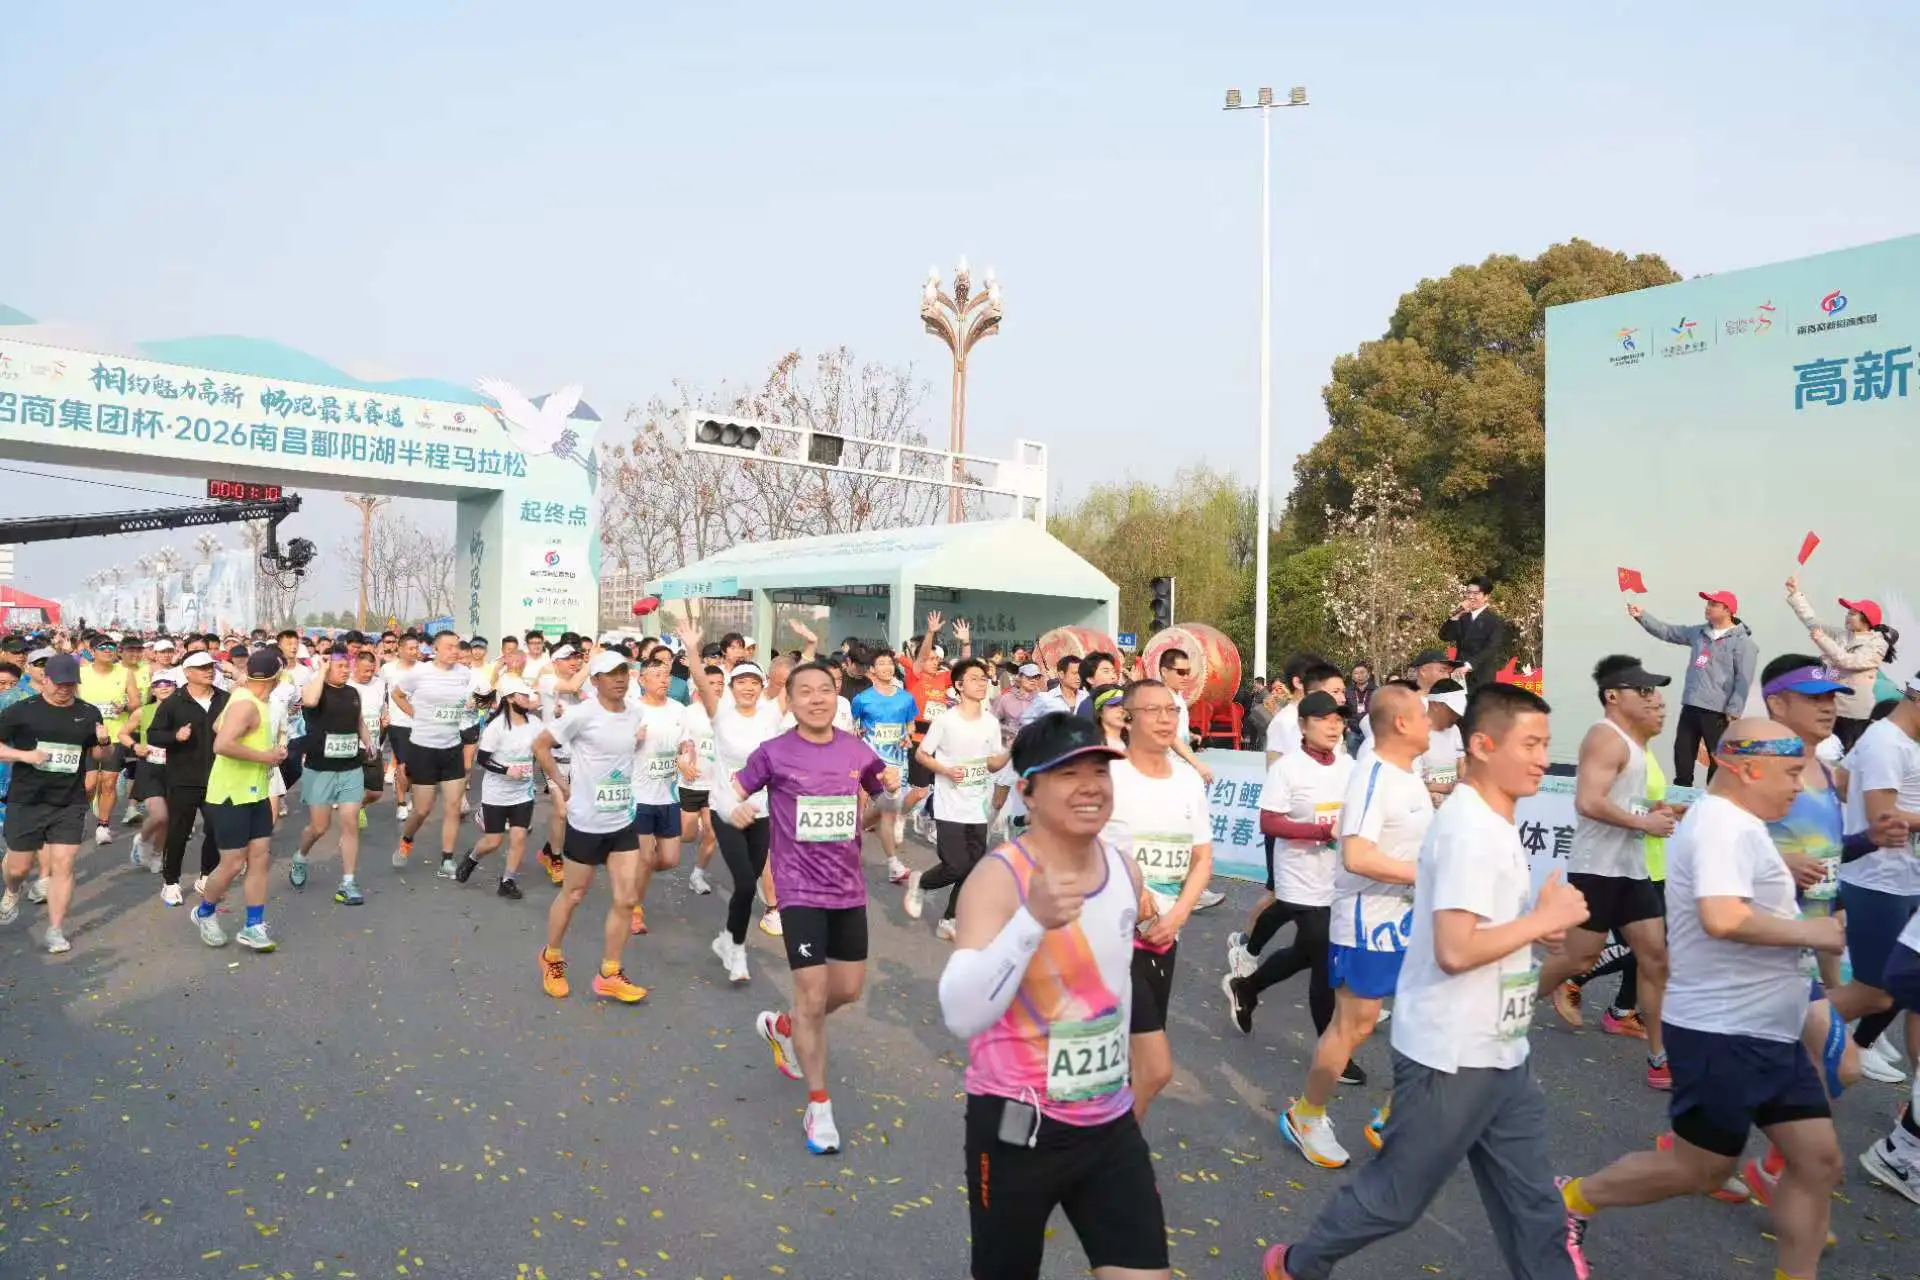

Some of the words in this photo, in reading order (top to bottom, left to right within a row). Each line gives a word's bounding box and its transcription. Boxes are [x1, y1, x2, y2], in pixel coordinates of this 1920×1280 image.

[88, 360, 245, 409] 相约魅力高新
[260, 384, 404, 429] 畅跑最美赛道
[1793, 345, 1920, 409] 高新
[520, 500, 588, 527] 起终点
[1203, 778, 1264, 810] 约鲤
[799, 810, 856, 828] A2388
[1519, 819, 1576, 860] 体育
